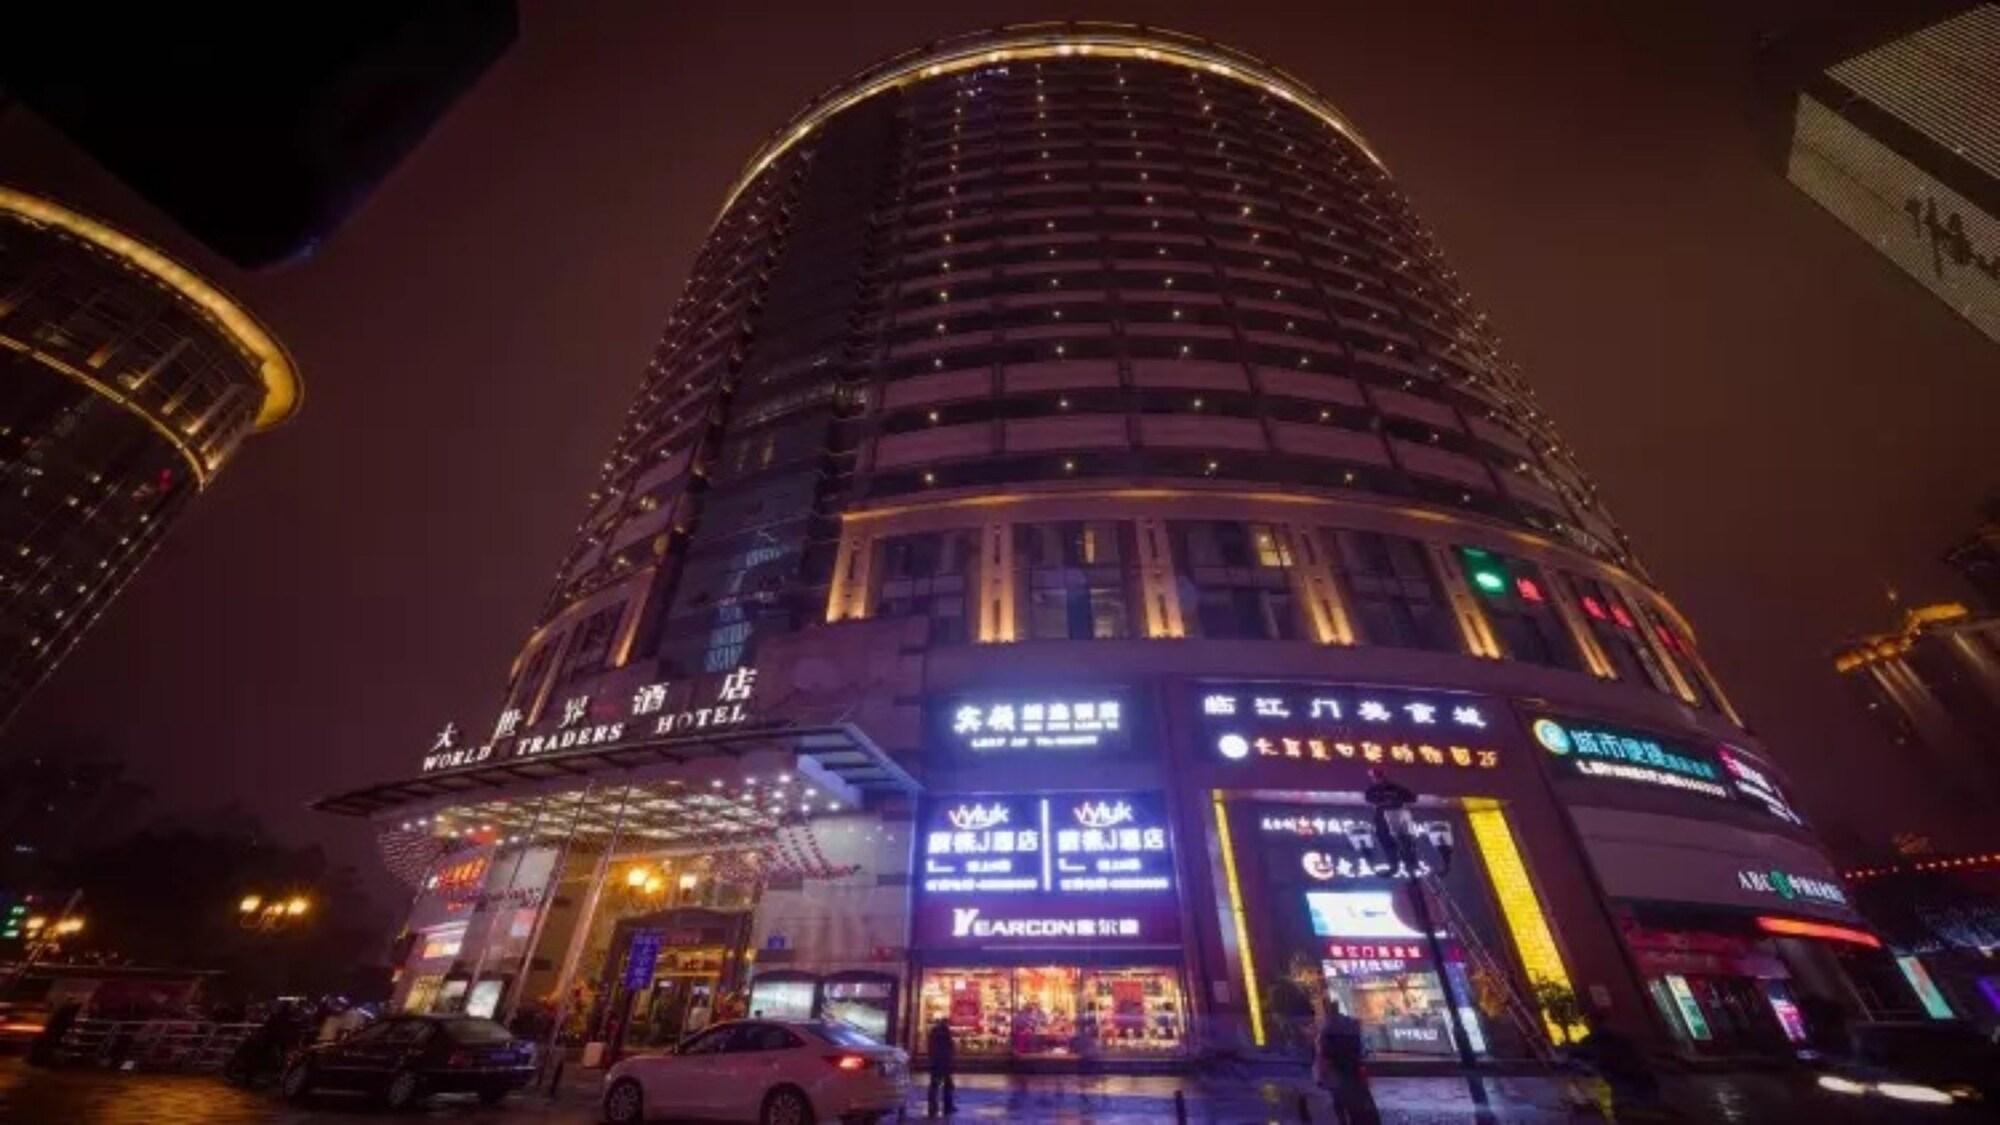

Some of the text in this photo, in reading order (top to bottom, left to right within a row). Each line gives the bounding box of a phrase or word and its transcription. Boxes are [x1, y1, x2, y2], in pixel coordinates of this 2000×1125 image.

[423, 702, 747, 772] WORLD TRADERS HOTEL
[432, 666, 757, 752] 大世界酒店
[952, 907, 1074, 937] YEARCON
